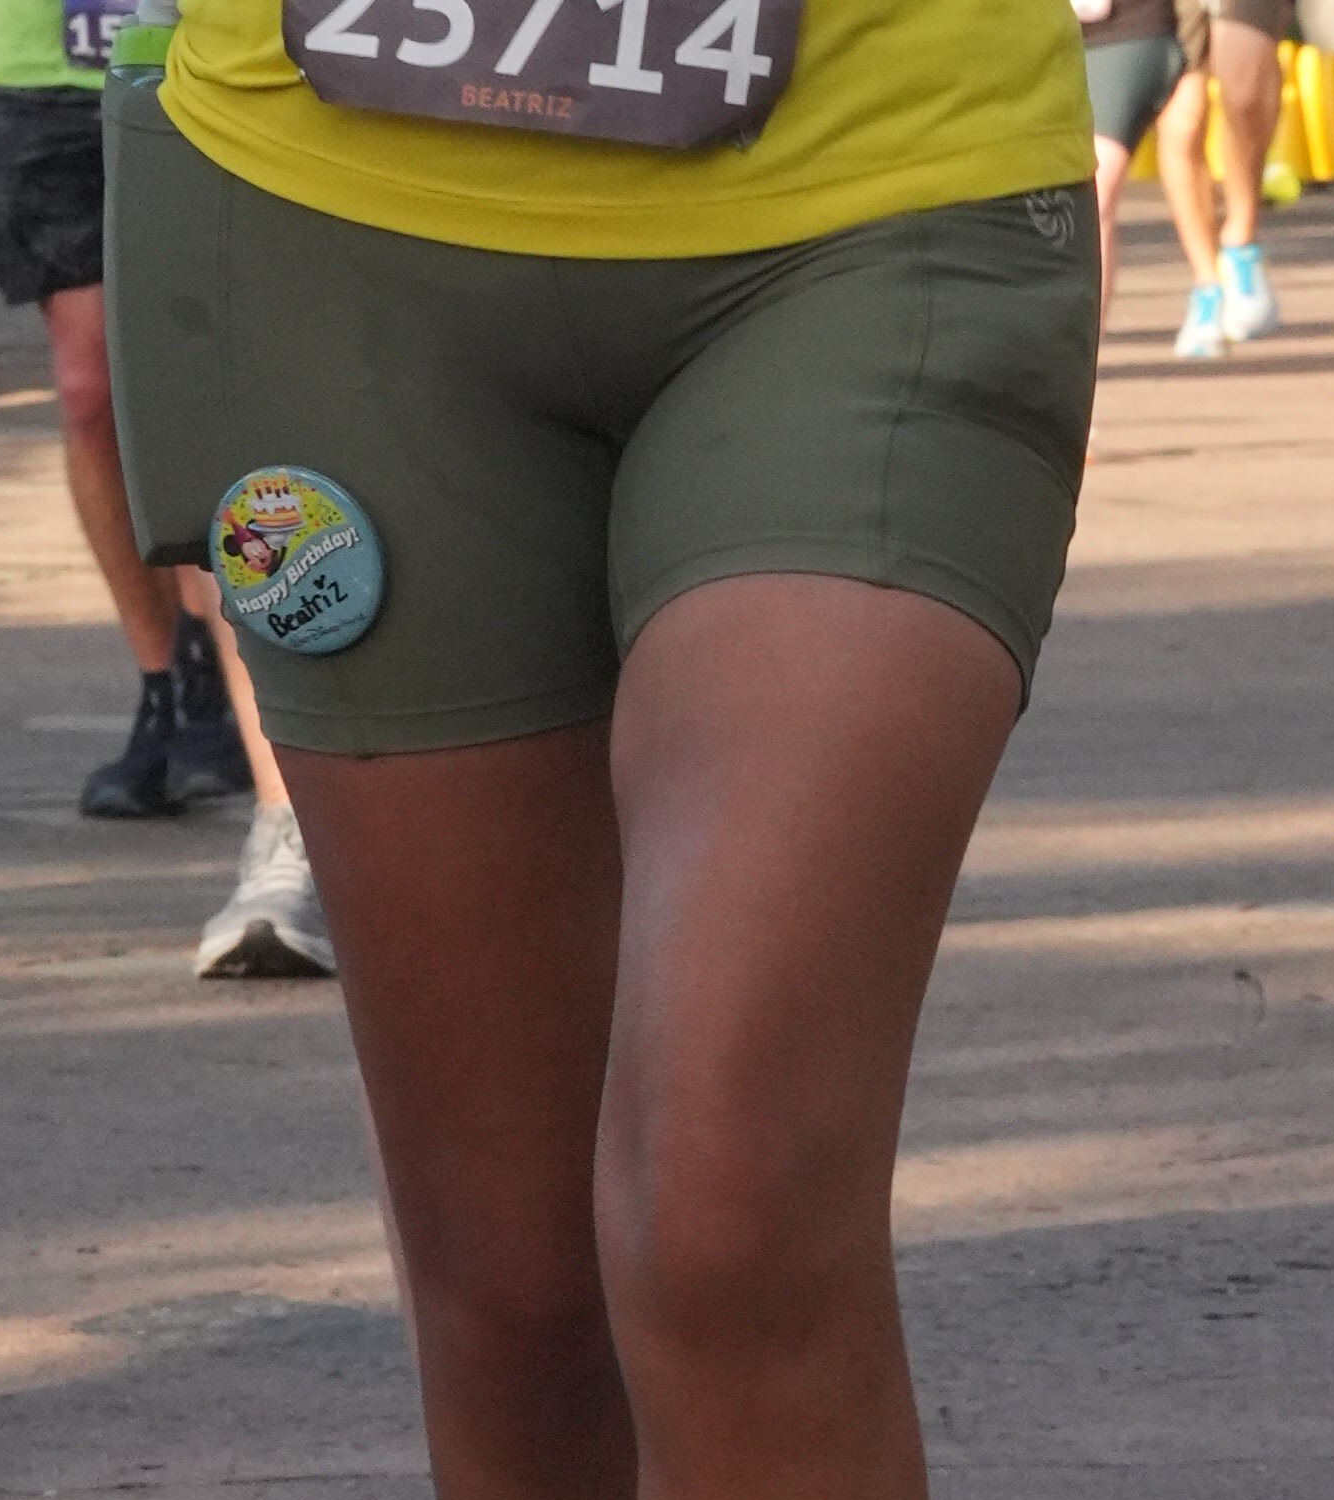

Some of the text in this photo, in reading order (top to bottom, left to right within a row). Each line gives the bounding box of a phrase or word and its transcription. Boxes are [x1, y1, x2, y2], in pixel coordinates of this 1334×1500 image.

[461, 84, 573, 119] BEATRIZ
[235, 526, 359, 614] Happy Birthday!
[267, 574, 349, 639] Beatriz
